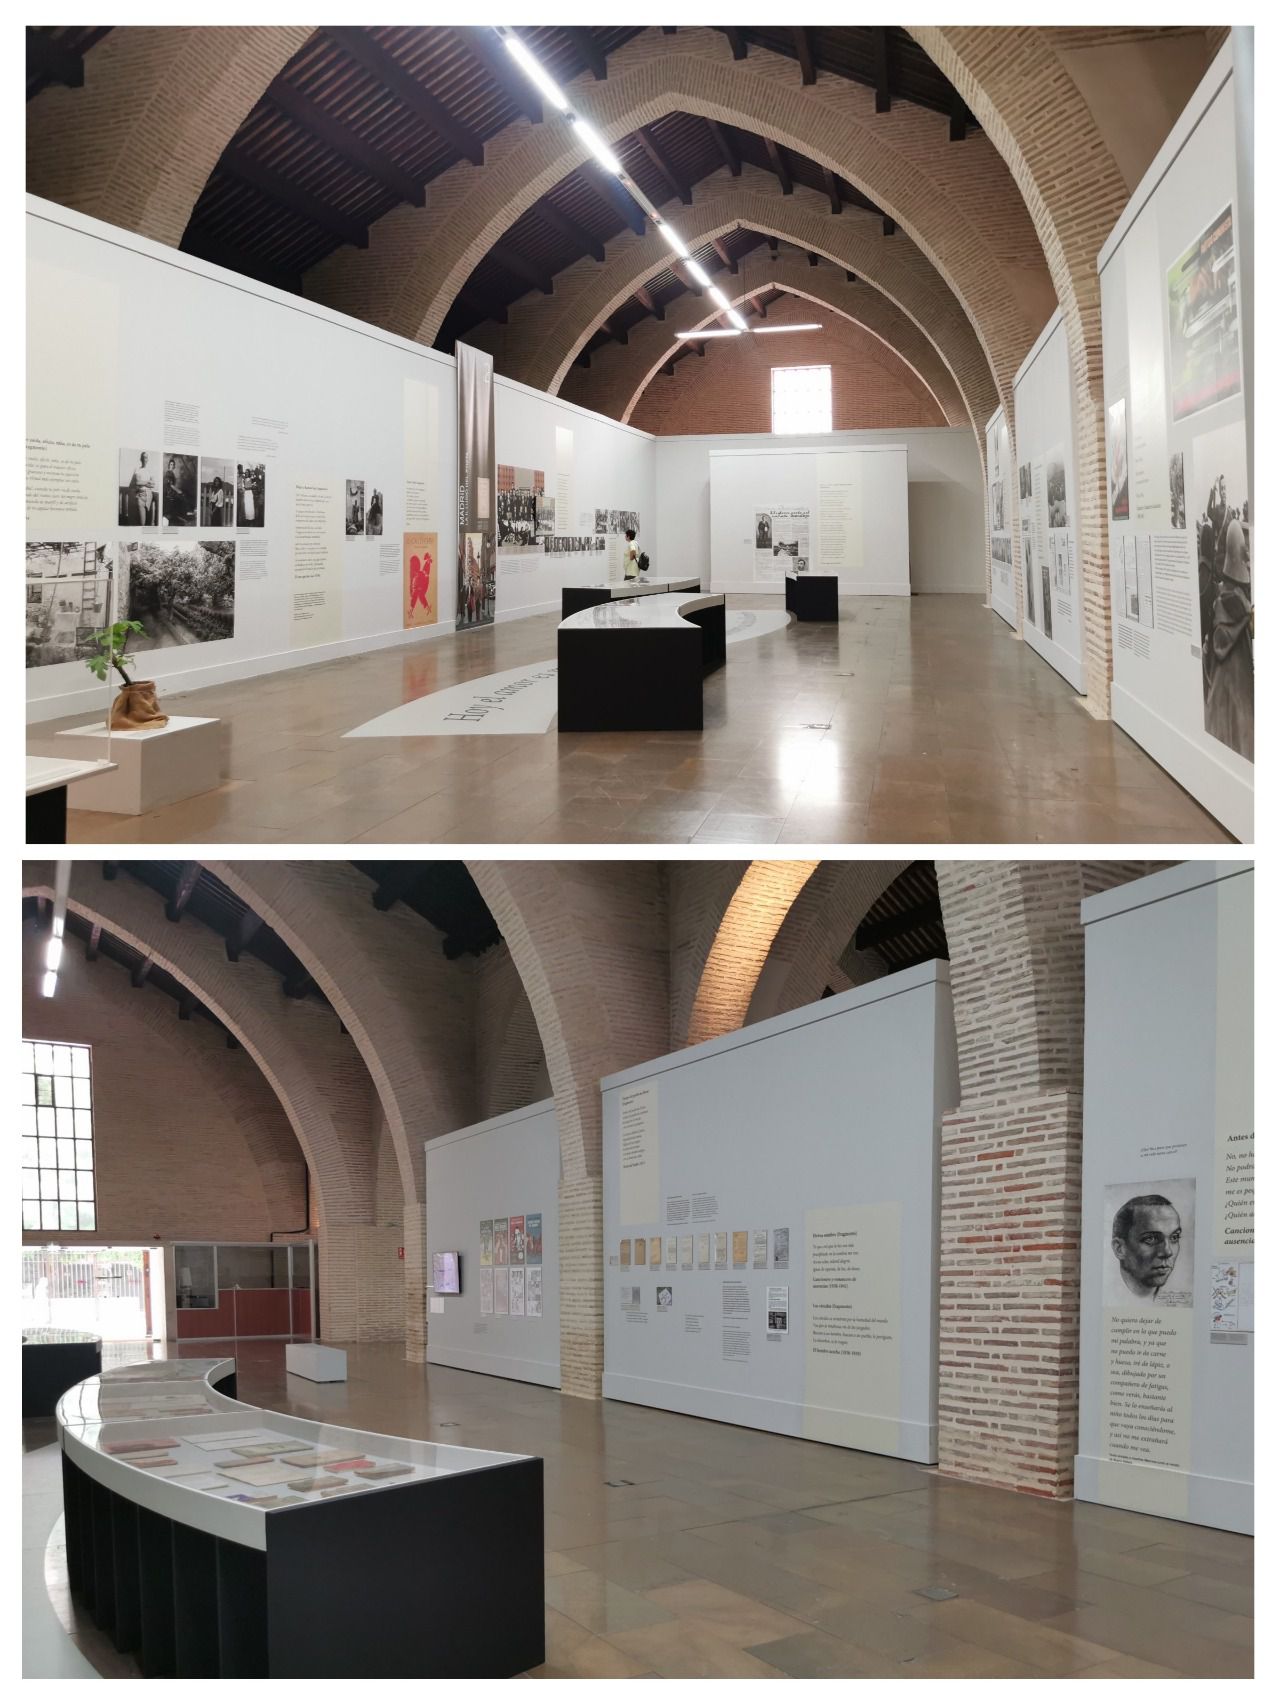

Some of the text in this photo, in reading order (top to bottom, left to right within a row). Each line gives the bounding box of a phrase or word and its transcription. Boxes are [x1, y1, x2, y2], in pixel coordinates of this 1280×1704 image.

[443, 704, 504, 722] Hoy
[494, 678, 537, 696] amor
[1227, 1134, 1249, 1142] Antes
[1225, 1176, 1238, 1184] Este
[1224, 1200, 1247, 1208] ¿Quién
[1224, 1211, 1247, 1220] ¿Quién
[1224, 1227, 1254, 1235] Cancion
[1147, 1329, 1157, 1337] que
